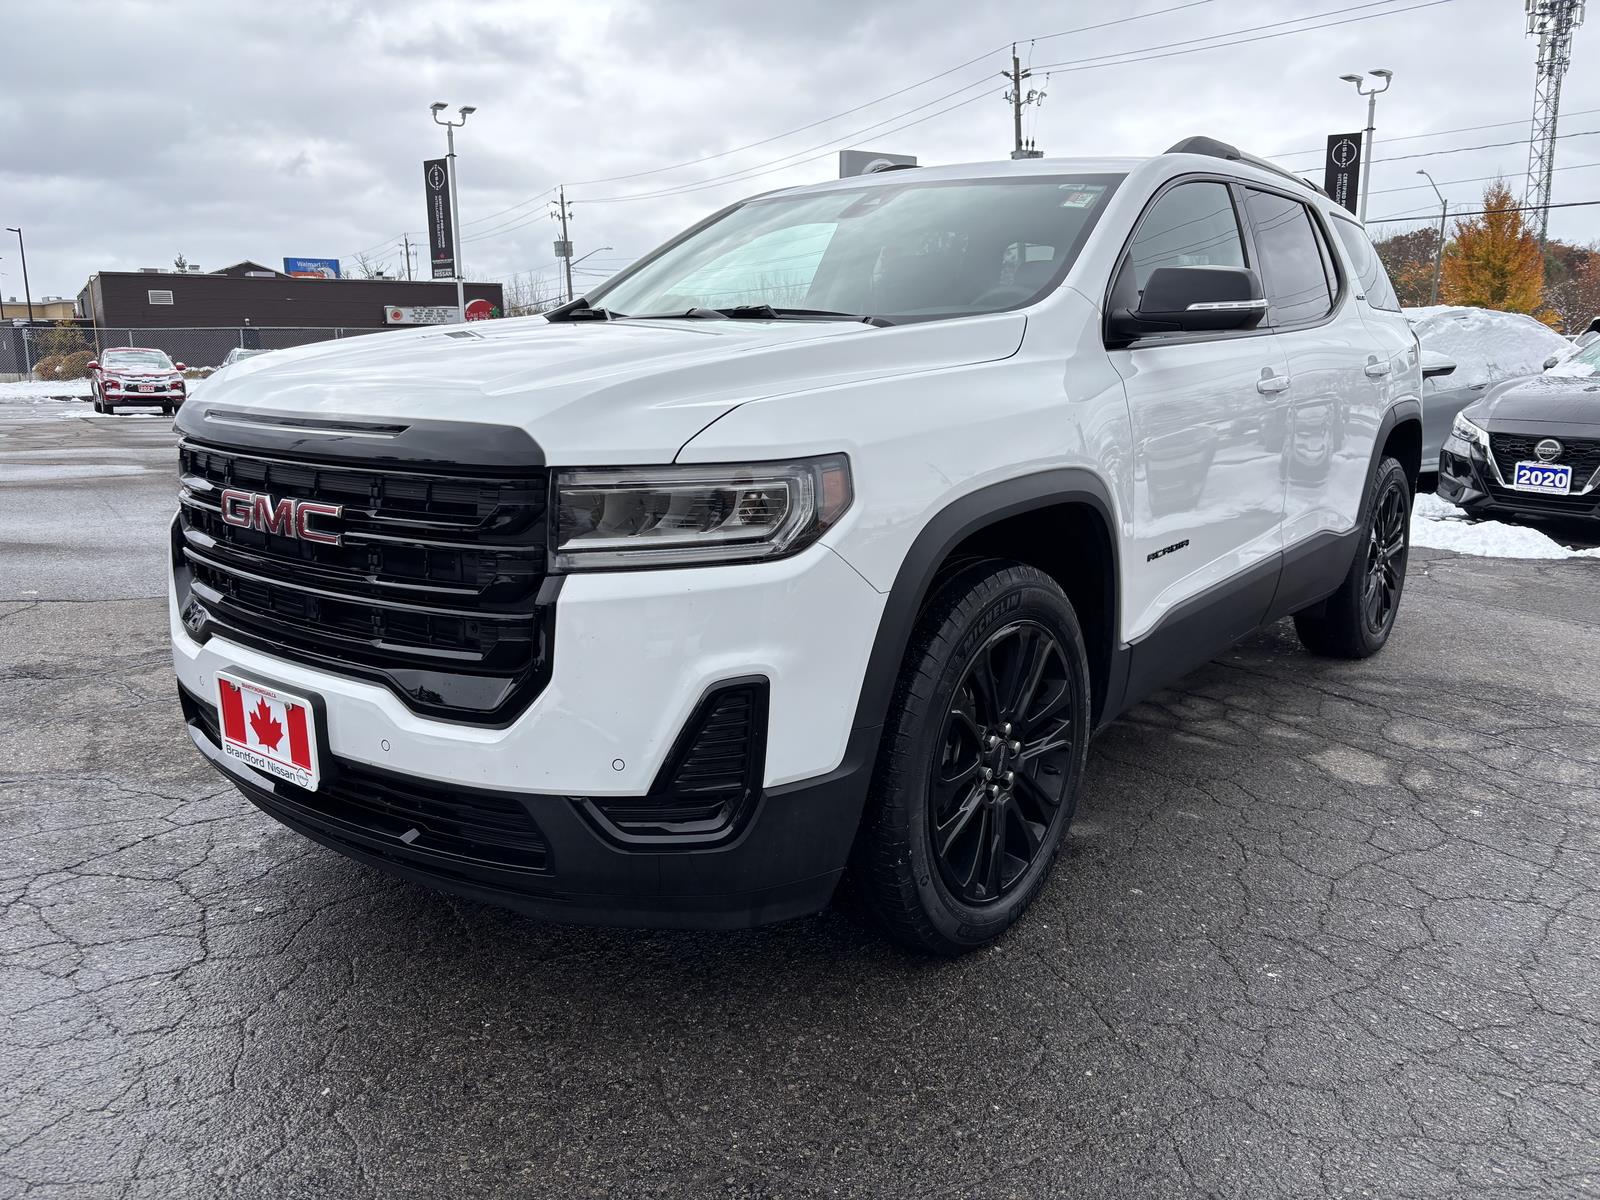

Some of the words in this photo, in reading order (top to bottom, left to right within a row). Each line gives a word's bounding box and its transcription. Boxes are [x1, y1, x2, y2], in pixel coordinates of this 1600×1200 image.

[1518, 470, 1568, 488] 2020
[220, 488, 343, 546] GMC
[962, 592, 1022, 655] MICHELIN
[226, 744, 265, 768] Brantford
[268, 762, 296, 782] Nissan
